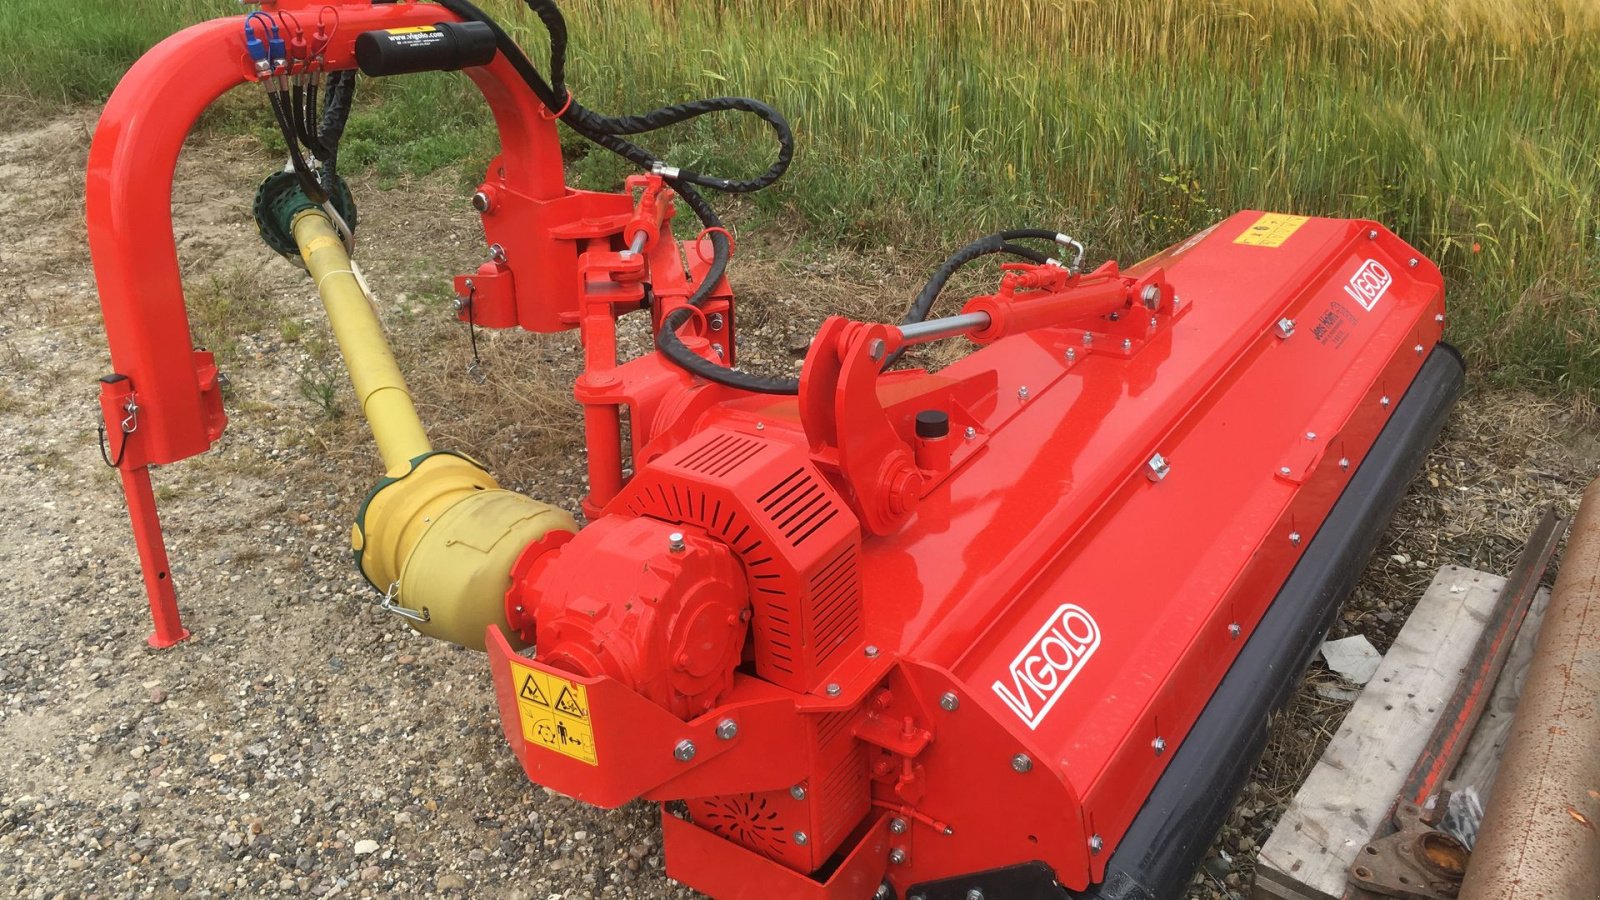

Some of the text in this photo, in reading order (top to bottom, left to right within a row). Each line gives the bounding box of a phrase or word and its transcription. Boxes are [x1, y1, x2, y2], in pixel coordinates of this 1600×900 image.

[388, 32, 444, 41] www.vigolo.com
[1343, 258, 1392, 312] VIGOLO
[991, 603, 1102, 731] VIGOLO
